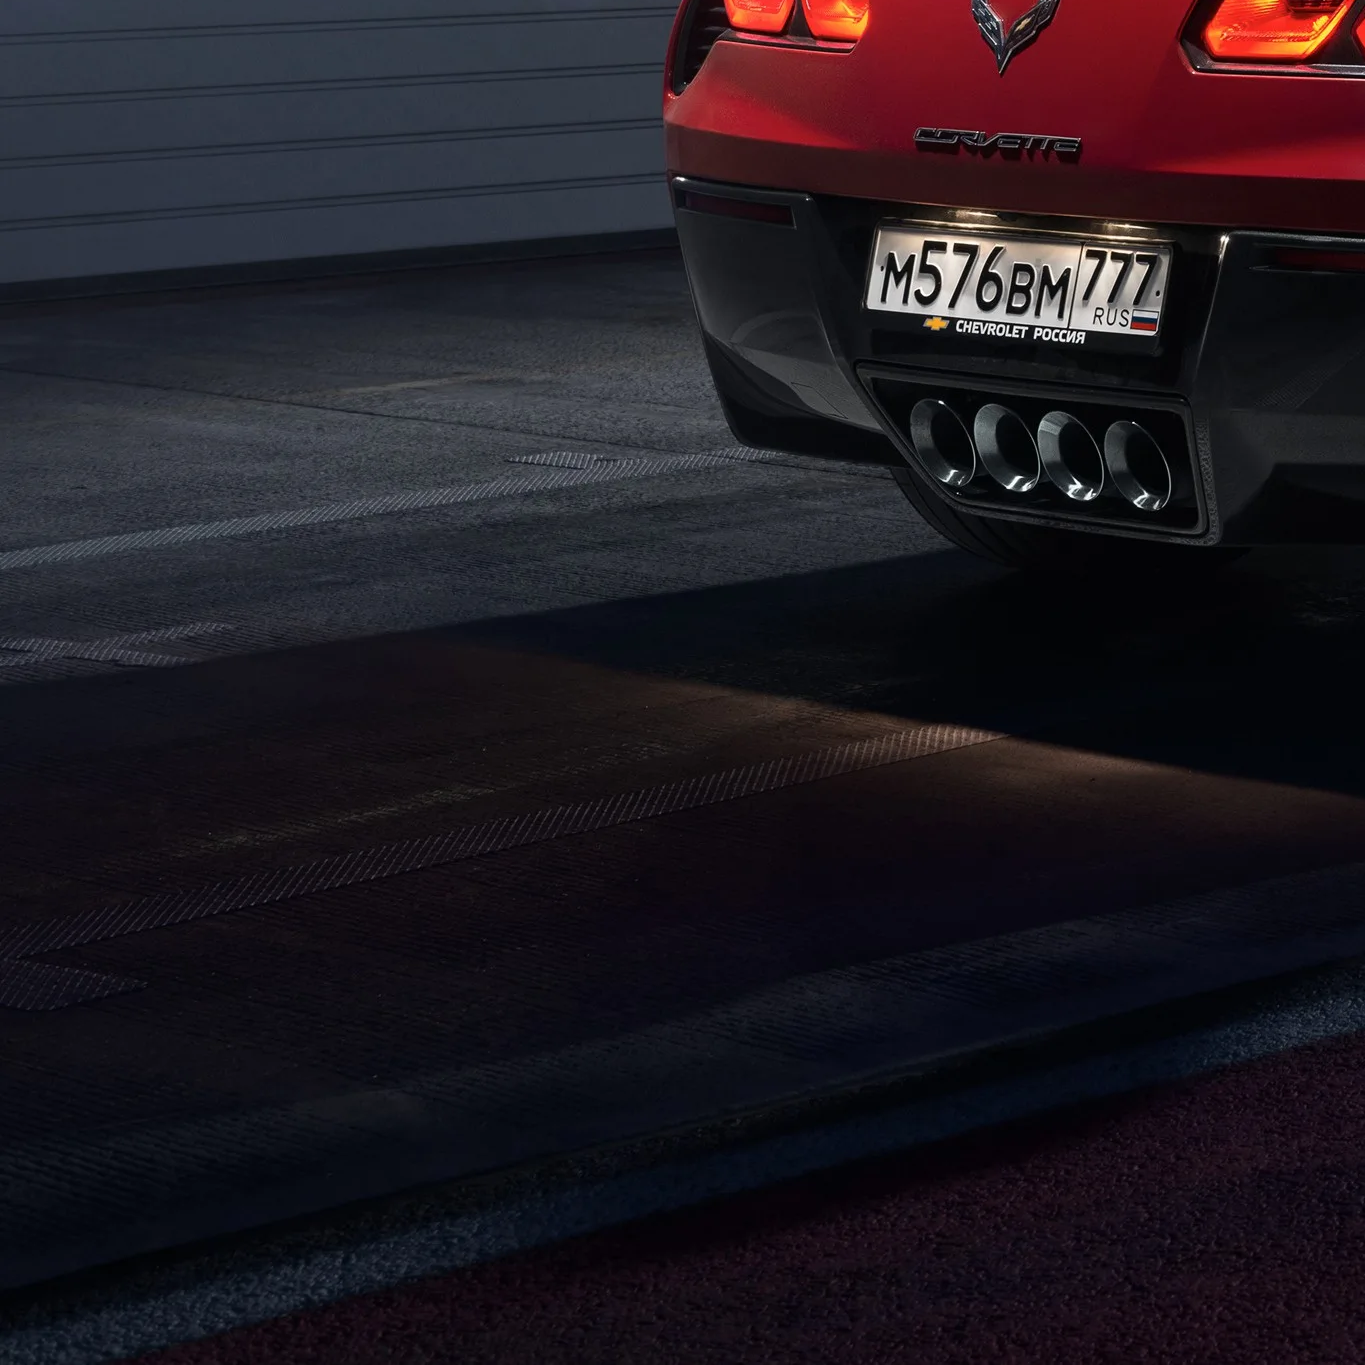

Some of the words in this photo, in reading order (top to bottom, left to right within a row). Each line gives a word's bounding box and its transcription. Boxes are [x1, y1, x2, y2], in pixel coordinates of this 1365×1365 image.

[913, 127, 1082, 152] CORVETTE
[1081, 248, 1160, 307] 777
[1092, 307, 1130, 327] RUS
[955, 319, 1028, 340] CHEVROLET
[1033, 327, 1087, 345] РОССИЯ
